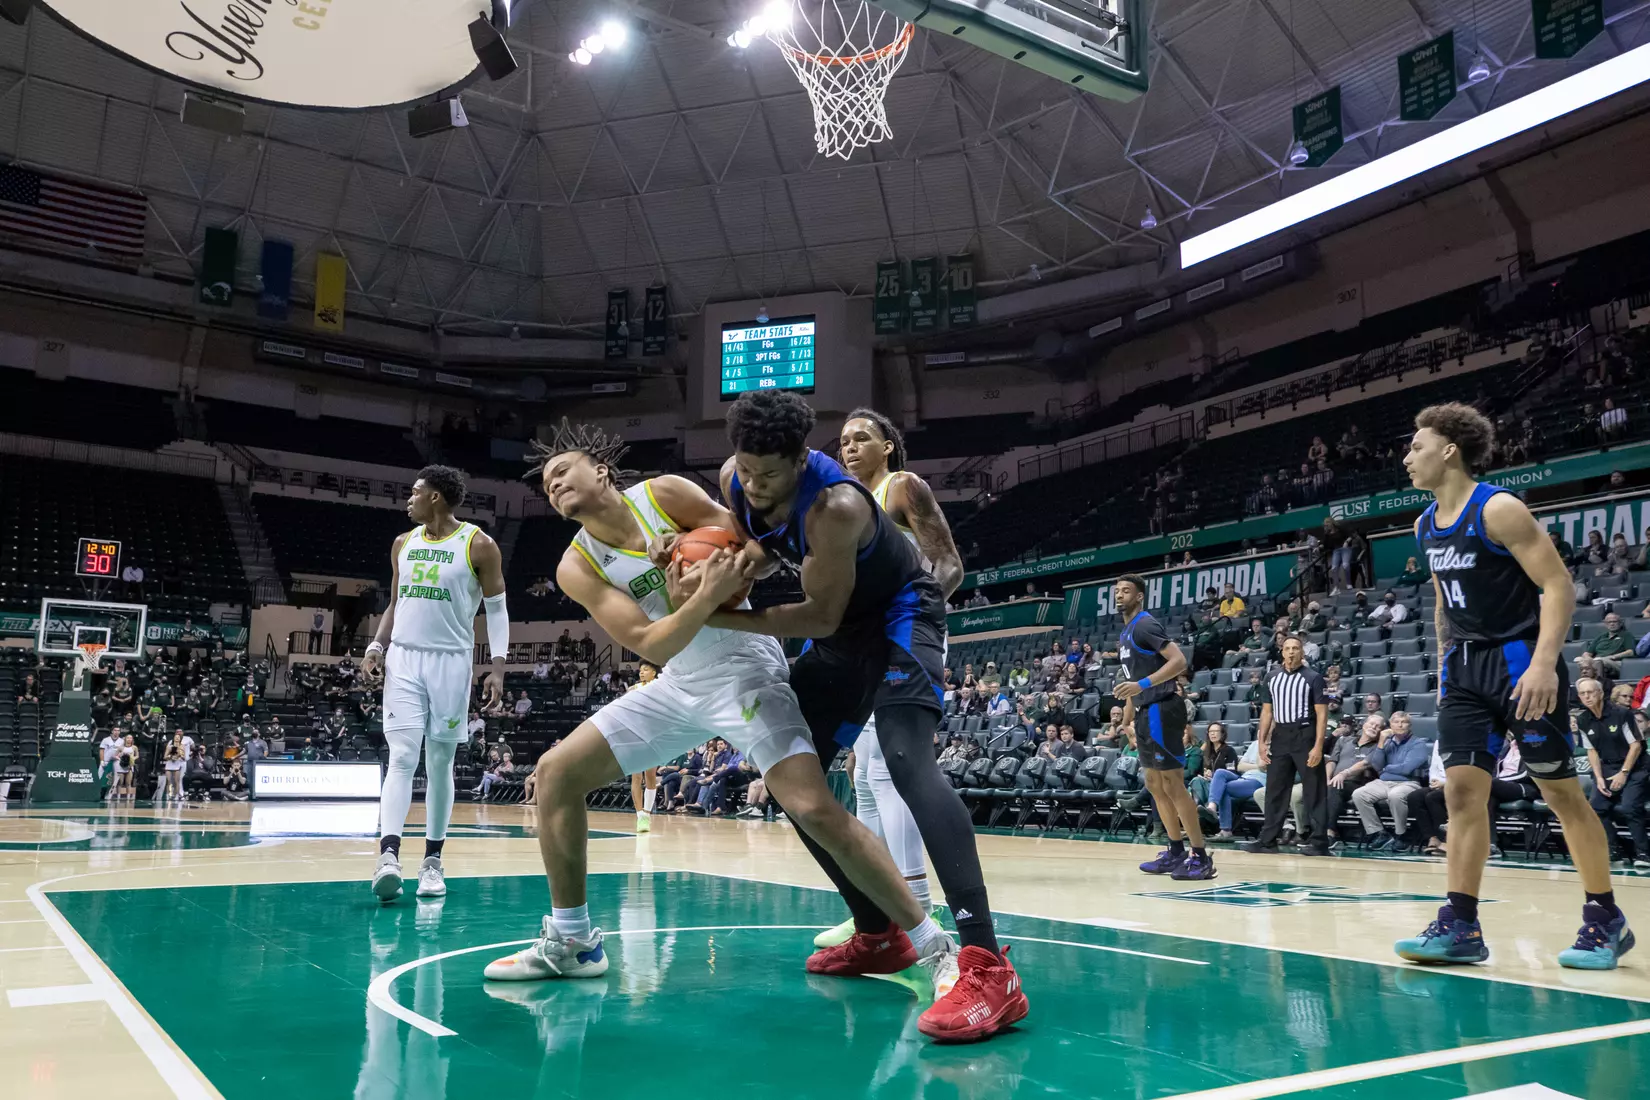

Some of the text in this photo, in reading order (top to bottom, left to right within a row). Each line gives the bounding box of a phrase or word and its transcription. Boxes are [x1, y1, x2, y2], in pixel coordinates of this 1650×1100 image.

[292, 0, 332, 30] CE
[878, 275, 900, 298] 25
[917, 272, 932, 294] 3
[647, 300, 665, 320] 12
[744, 328, 767, 340] TEAM
[769, 325, 794, 338] STATS
[42, 340, 65, 352] 327
[762, 340, 775, 349] FGs
[755, 351, 781, 362] 3PT FGs
[762, 365, 774, 374] FTs
[729, 381, 737, 391] 21
[1344, 491, 1437, 516] USF FEDERAL
[1171, 533, 1194, 550] 202
[86, 553, 110, 573] 30
[407, 548, 455, 564] SOUTH
[1425, 545, 1478, 572] Tulsa
[411, 562, 441, 587] 54
[984, 571, 1000, 582] USF
[1003, 567, 1034, 578] FEDERAL
[1036, 560, 1063, 573] CREDIT
[628, 567, 667, 599] SO
[1096, 560, 1267, 617] SOH FLORIDA
[399, 585, 452, 602] FLORIDA
[1440, 580, 1467, 608] 14
[1, 618, 29, 630] THE
[55, 730, 75, 738] Blue
[56, 723, 89, 731] Florida
[46, 770, 67, 778] TGH
